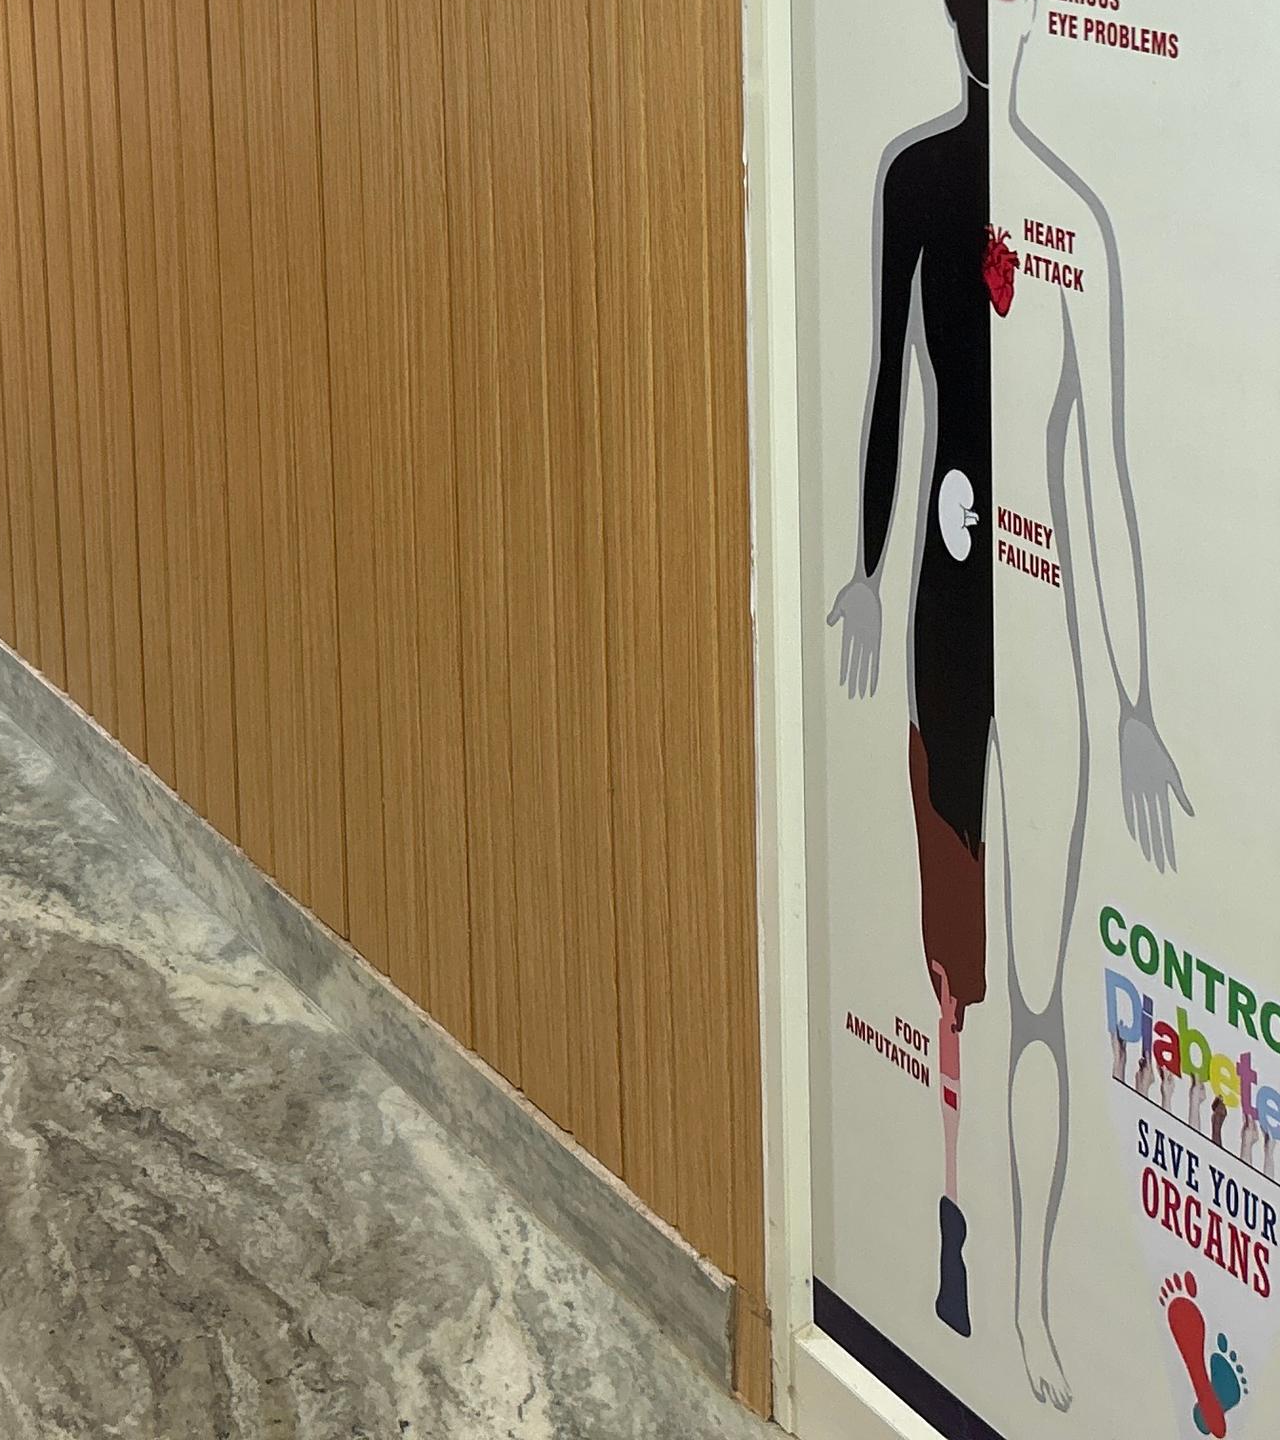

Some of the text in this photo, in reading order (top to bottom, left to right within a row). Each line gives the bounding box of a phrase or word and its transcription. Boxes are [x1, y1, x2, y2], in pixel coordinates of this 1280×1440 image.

[1047, 11, 1179, 60] EYE PROBLEMS
[1023, 218, 1076, 254] HEART
[1022, 252, 1084, 293] ATTACK
[997, 506, 1053, 549] KIDNEY
[997, 540, 1060, 588] FAILURE
[845, 1010, 930, 1088] AMPUTATION
[894, 1015, 930, 1056] FOOT
[1137, 1118, 1279, 1247] SAVE YOUR
[1141, 1166, 1271, 1299] ORGANS
